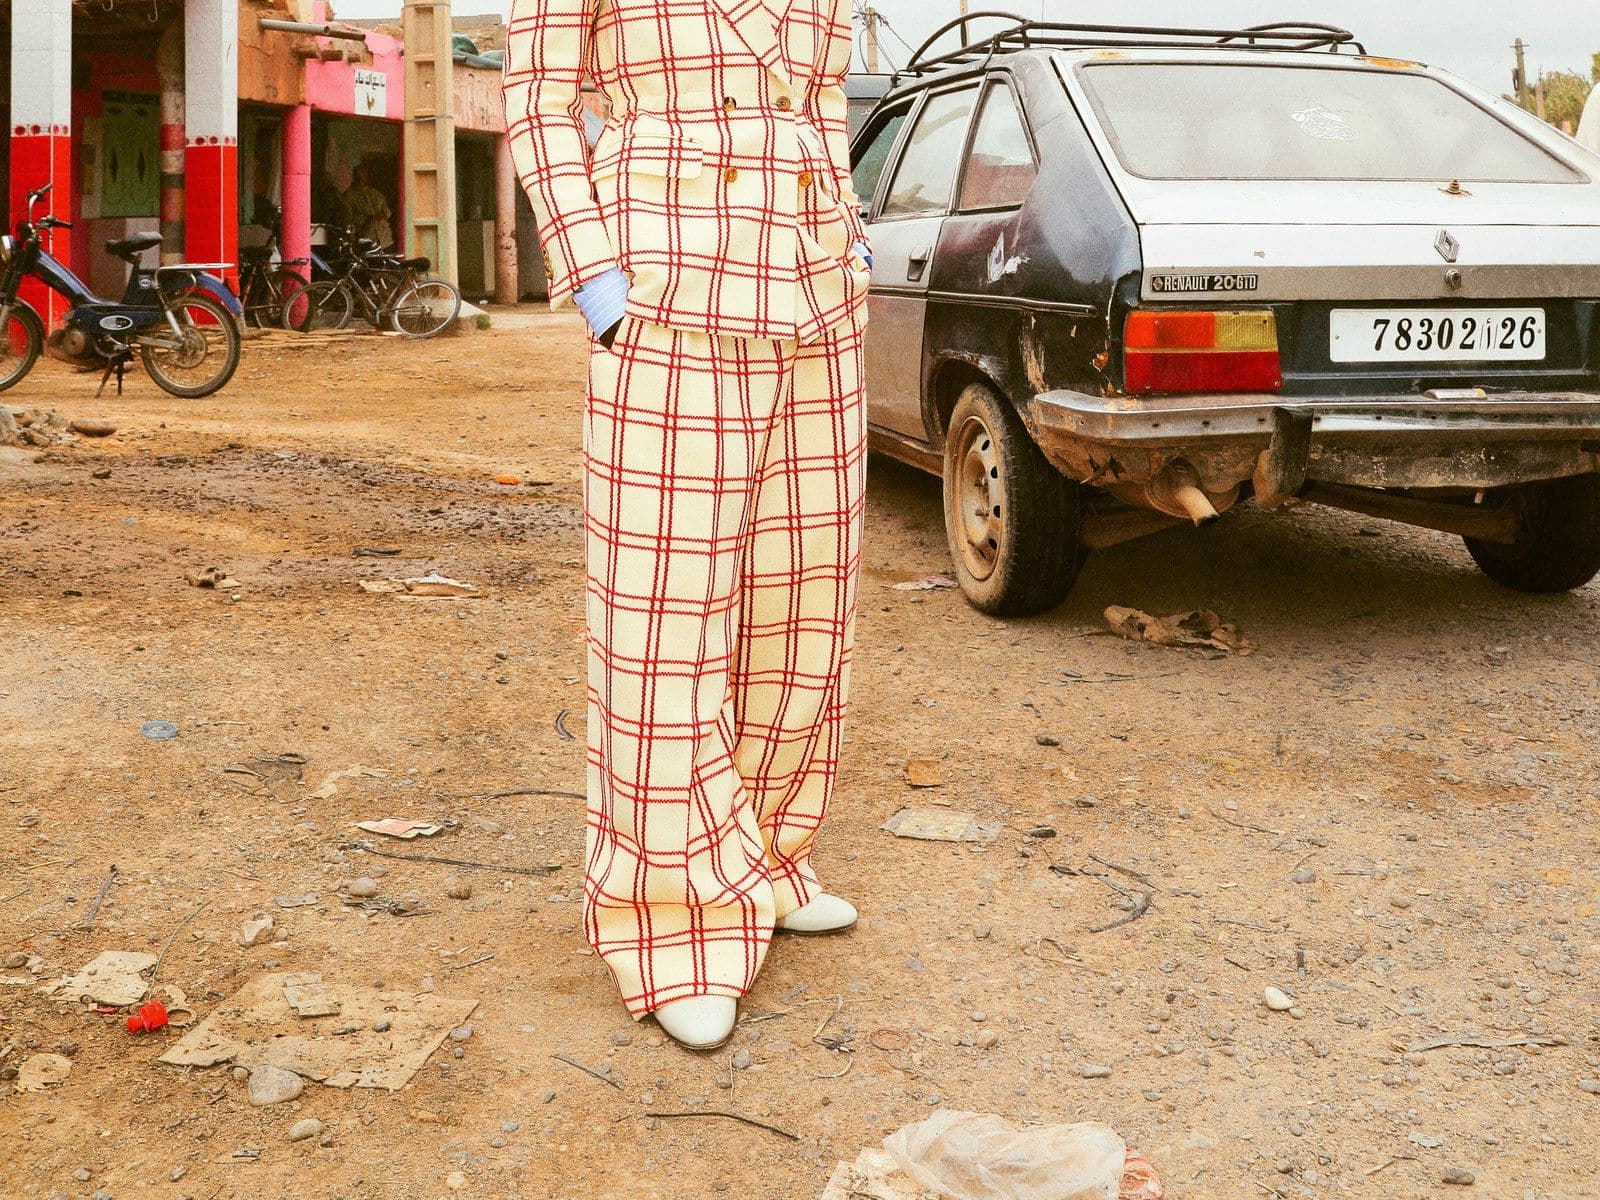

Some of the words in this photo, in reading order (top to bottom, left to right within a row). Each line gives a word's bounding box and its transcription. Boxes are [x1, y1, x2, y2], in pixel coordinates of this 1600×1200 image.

[1164, 276, 1210, 291] RENAULT
[1213, 275, 1234, 290] 20
[1236, 275, 1256, 290] GTD
[1373, 317, 1477, 351] 78302
